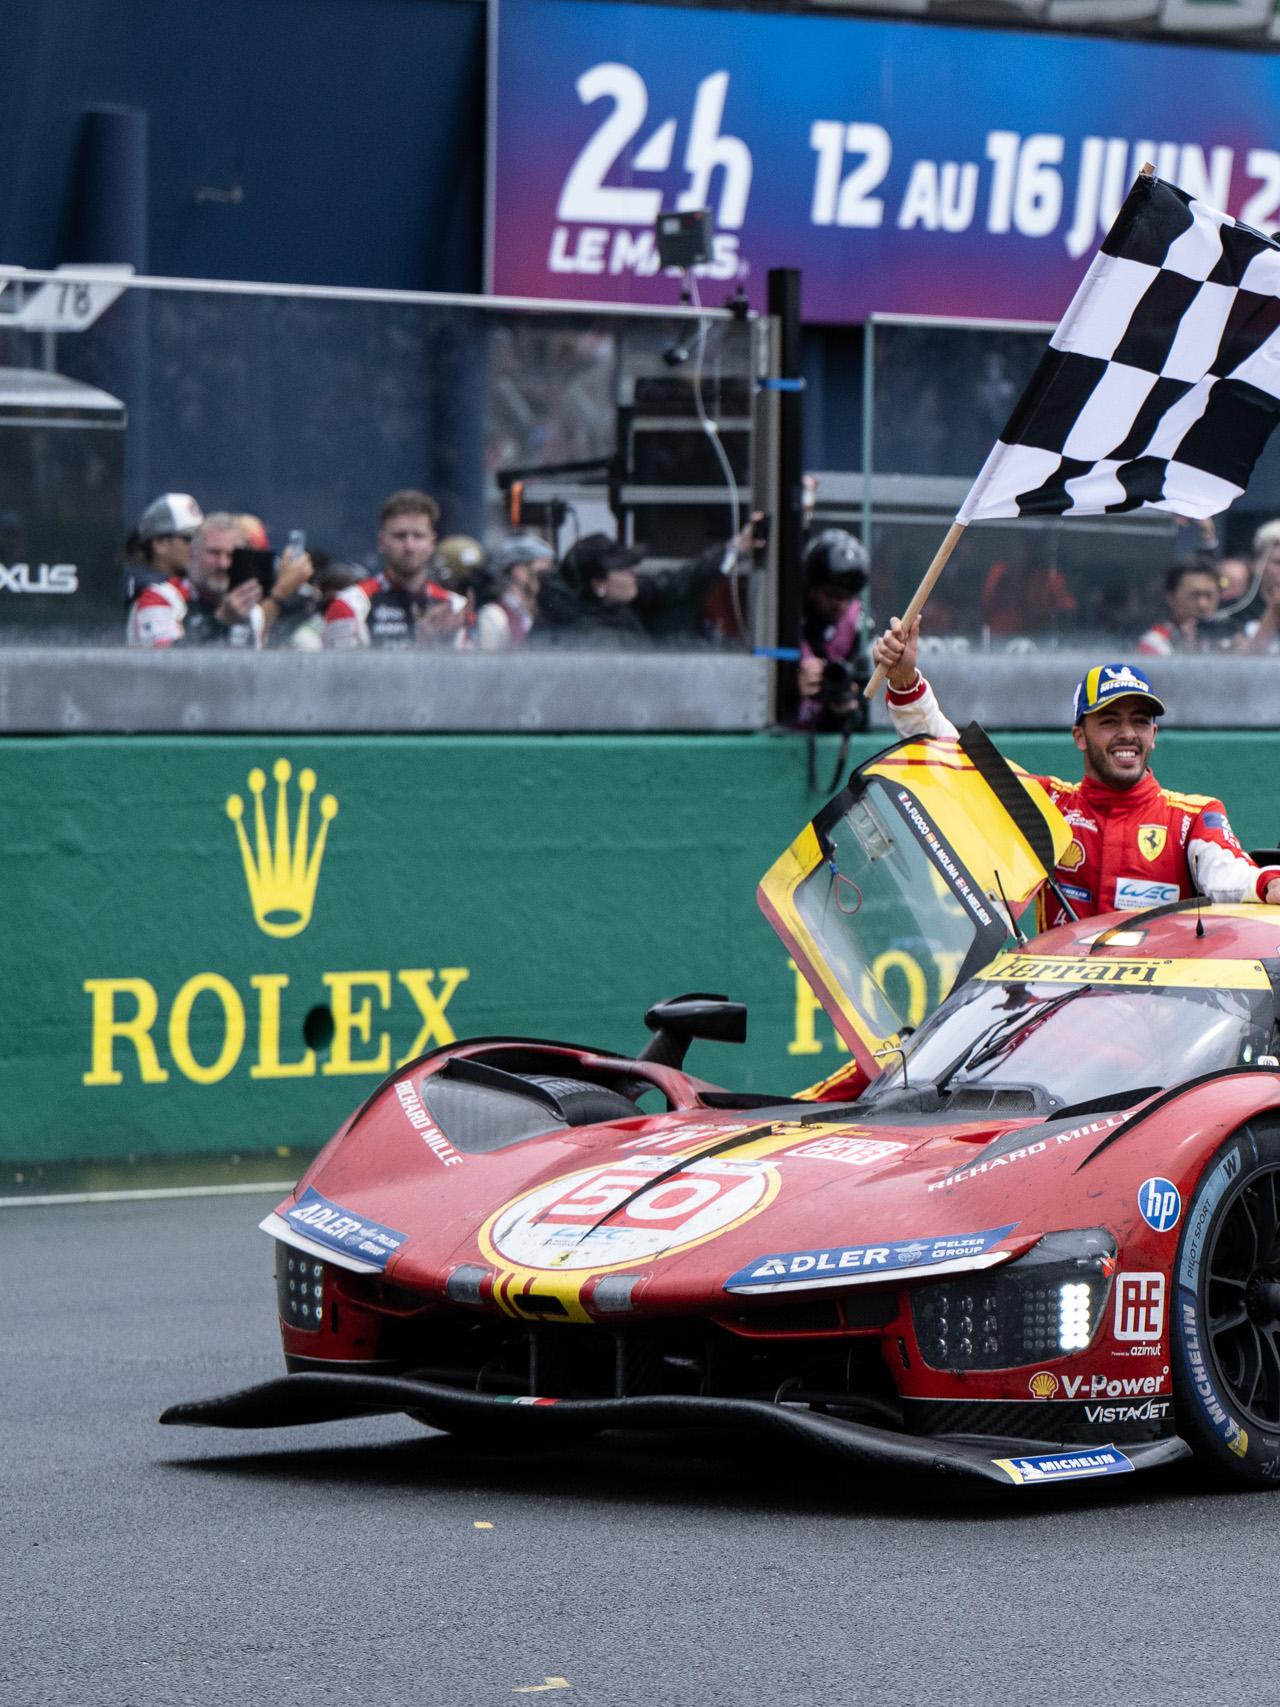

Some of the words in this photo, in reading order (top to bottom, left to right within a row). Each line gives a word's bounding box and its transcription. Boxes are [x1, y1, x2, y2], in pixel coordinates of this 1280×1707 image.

[811, 121, 892, 229] 12
[899, 160, 975, 233] AU
[986, 131, 1064, 238] 16
[548, 226, 610, 274] LE
[609, 229, 740, 280] MS
[988, 956, 1159, 983] Ferrari
[83, 968, 470, 1086] ROLEX
[394, 1079, 432, 1130] RICHARD
[420, 1128, 463, 1167] MILLE
[928, 1142, 1047, 1193] RICHARD
[1055, 1110, 1138, 1145] MILLE
[549, 1174, 721, 1221] 50
[1146, 1178, 1176, 1230] hp
[289, 1203, 362, 1240] ADLER
[751, 1247, 890, 1278] ADLER
[932, 1246, 983, 1258] GROUP
[934, 1238, 985, 1250] PELZER
[1131, 1341, 1161, 1356] azimut
[1183, 1303, 1227, 1425] MICHELIN
[1061, 1374, 1165, 1399] V-Power
[1038, 1453, 1116, 1472] MICHELIN
